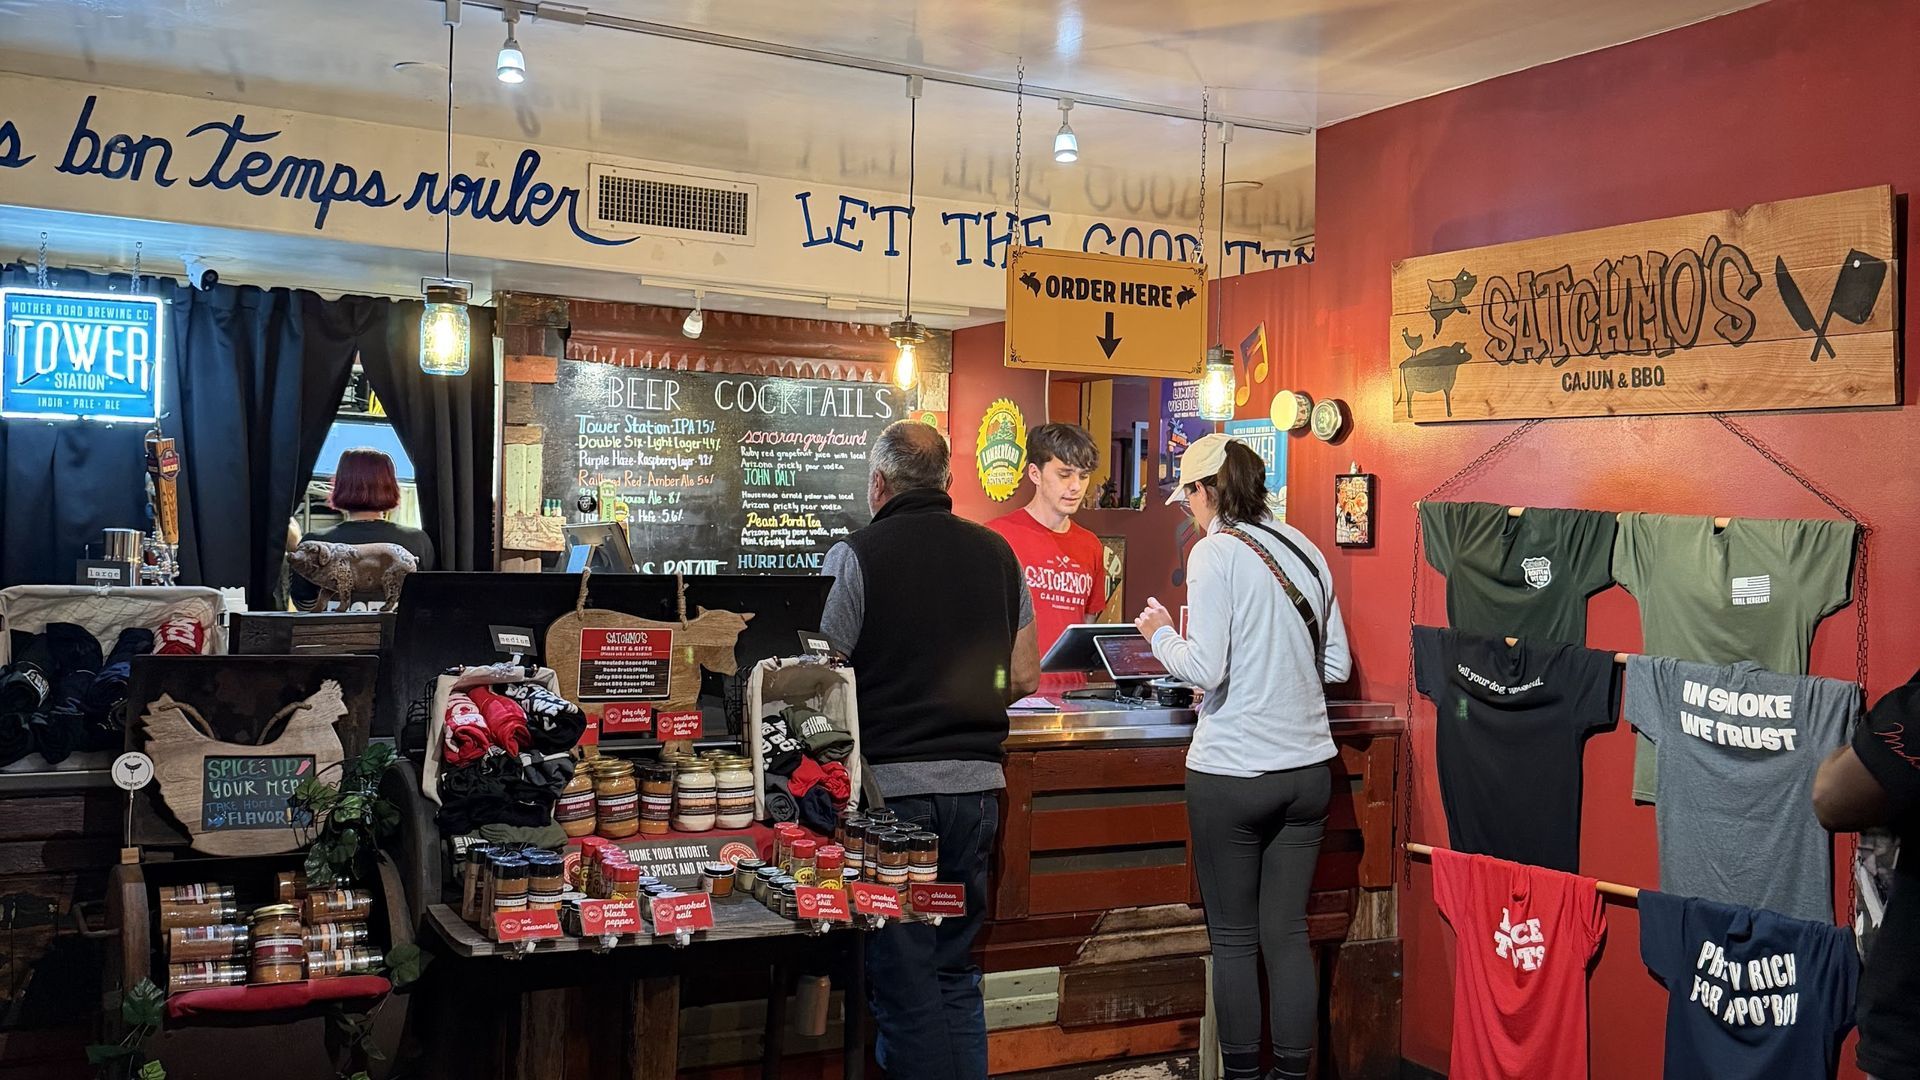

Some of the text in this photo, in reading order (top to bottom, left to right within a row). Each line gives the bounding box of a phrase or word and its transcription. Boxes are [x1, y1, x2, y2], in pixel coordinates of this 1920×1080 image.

[55, 95, 178, 187] bon
[404, 149, 641, 246] rouler
[795, 191, 915, 258] LET
[941, 211, 1052, 269] THE
[1045, 275, 1173, 308] ORDER HERE
[1481, 235, 1762, 366] SATCHMO'S
[12, 302, 153, 321] MOTHER ROAD BREWING CO.
[8, 319, 149, 392] TOWER
[54, 372, 106, 391] STATION
[1561, 365, 1666, 392] CAJUN & BBQ
[607, 376, 681, 411] BEER
[714, 380, 893, 420] COCKTAILS
[38, 397, 120, 410] INDIA PALE ALE
[575, 414, 621, 435] Tower
[674, 437, 702, 453] Lager
[802, 429, 868, 452] greyhound
[579, 450, 610, 470] Purple
[637, 452, 677, 471] Raspberry
[677, 454, 695, 471] Lager
[740, 446, 759, 459] Ruby
[761, 449, 774, 457] red
[777, 448, 812, 461] grapefruit
[850, 451, 867, 460] local
[740, 458, 773, 468] Arizona
[777, 461, 802, 471] prickly
[624, 470, 695, 487] Red Amber Ale
[743, 468, 796, 487] JOHN DALY
[647, 489, 681, 506] Ale 8%
[781, 491, 802, 499] arnold
[742, 500, 770, 509] Arizona
[773, 502, 799, 513] prickly
[820, 503, 842, 511] vodka
[745, 512, 822, 528] Peach Porch Tea
[741, 527, 770, 537] Arizona
[770, 528, 791, 538] prickly
[737, 552, 825, 569] HURRICANE
[88, 568, 120, 579] large
[1040, 592, 1065, 603] CAJUN
[500, 636, 529, 645] medium
[605, 632, 648, 645] SATCHMO'S
[1457, 664, 1507, 695] tell your dog
[1682, 680, 1708, 708] IN
[621, 708, 646, 717] bbq chip
[621, 715, 651, 724] seasoning
[673, 714, 699, 722] southern
[687, 721, 699, 729] dry
[1680, 711, 1797, 751] WE TRUST
[207, 759, 260, 779] SPICE
[208, 780, 259, 799] YOUR
[206, 802, 238, 812] TAKE
[629, 849, 651, 861] HOME
[651, 847, 673, 860] YOUR
[674, 845, 710, 860] FAVORITE
[651, 863, 677, 877] SPICES
[678, 862, 696, 875] AND
[871, 894, 896, 902] smoked
[931, 891, 957, 899] chicken
[602, 901, 635, 910] smoked
[675, 900, 706, 911] smoked
[872, 901, 899, 910] paprika
[931, 899, 964, 908] seasoning
[604, 909, 627, 918] black
[676, 910, 692, 920] salt
[522, 922, 558, 932] seasoning
[604, 918, 635, 928] pepper
[1747, 952, 1797, 991] RICH
[1689, 974, 1723, 1016] FOR
